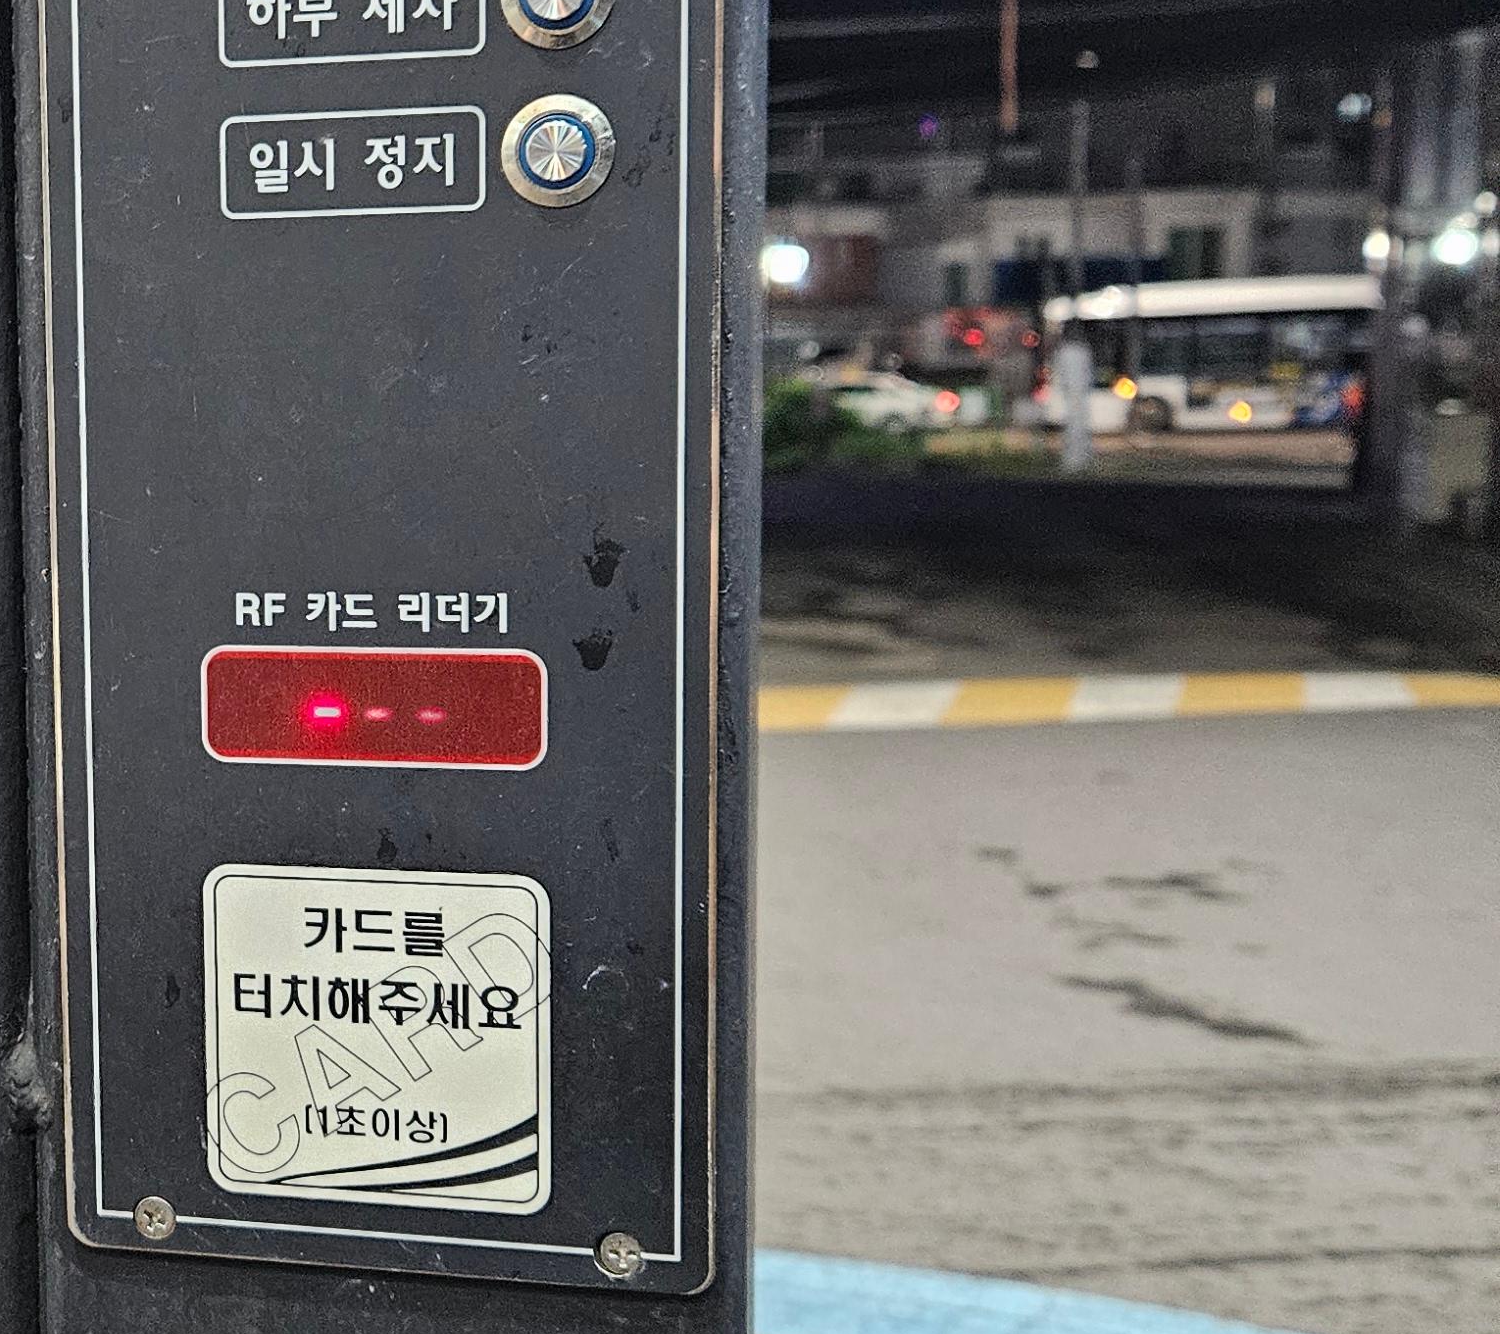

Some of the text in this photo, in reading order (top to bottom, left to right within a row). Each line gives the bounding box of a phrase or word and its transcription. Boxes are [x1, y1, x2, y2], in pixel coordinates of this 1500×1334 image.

[249, 133, 456, 194] 일시 정지
[235, 591, 510, 634] RF 카드 리더기
[304, 907, 445, 957] 카드를
[233, 972, 522, 1030] 터치해주세요
